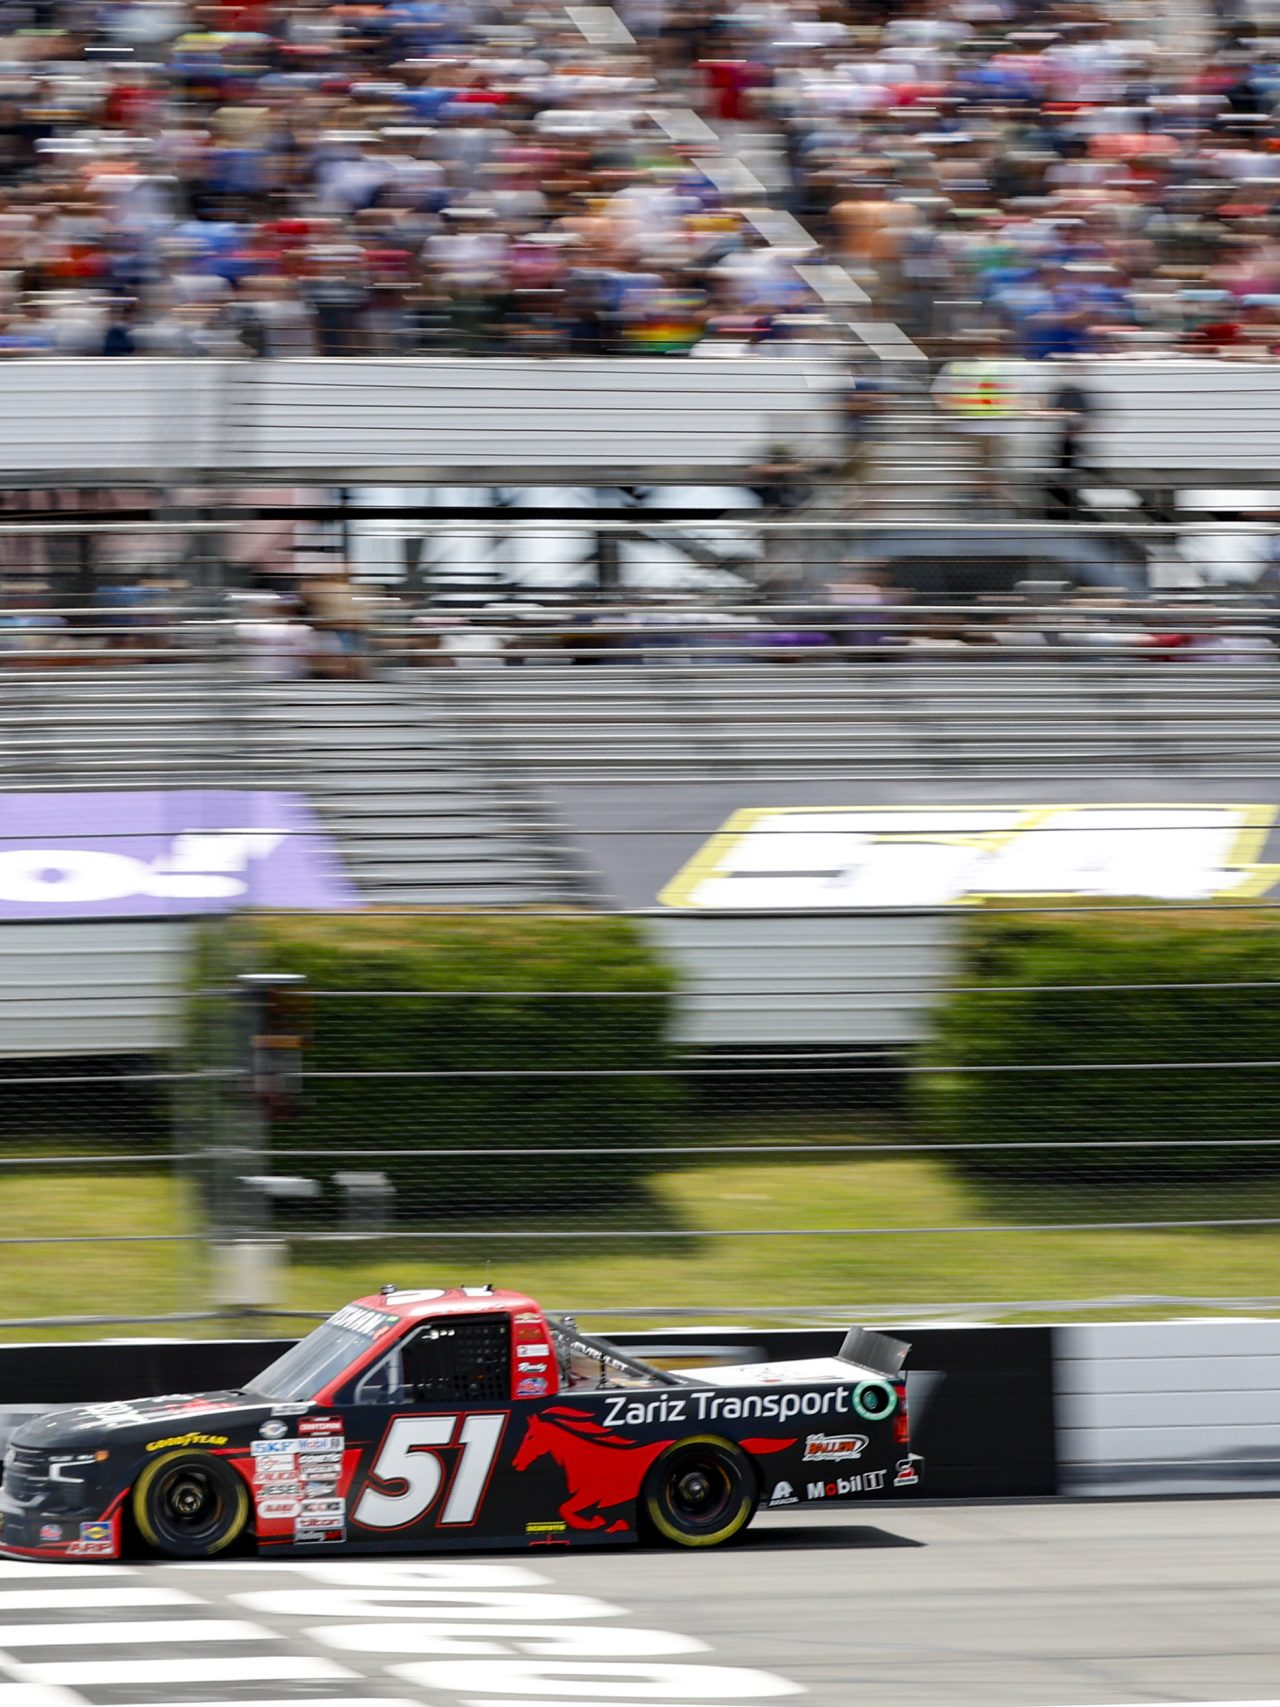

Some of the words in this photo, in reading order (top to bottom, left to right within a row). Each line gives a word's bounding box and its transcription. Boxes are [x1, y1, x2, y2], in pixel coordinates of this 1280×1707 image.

[603, 1394, 687, 1427] Zariz
[691, 1386, 850, 1423] Transport
[145, 1431, 229, 1452] GOODYEAR
[351, 1412, 510, 1529] 51
[807, 1473, 862, 1500] Mobil
